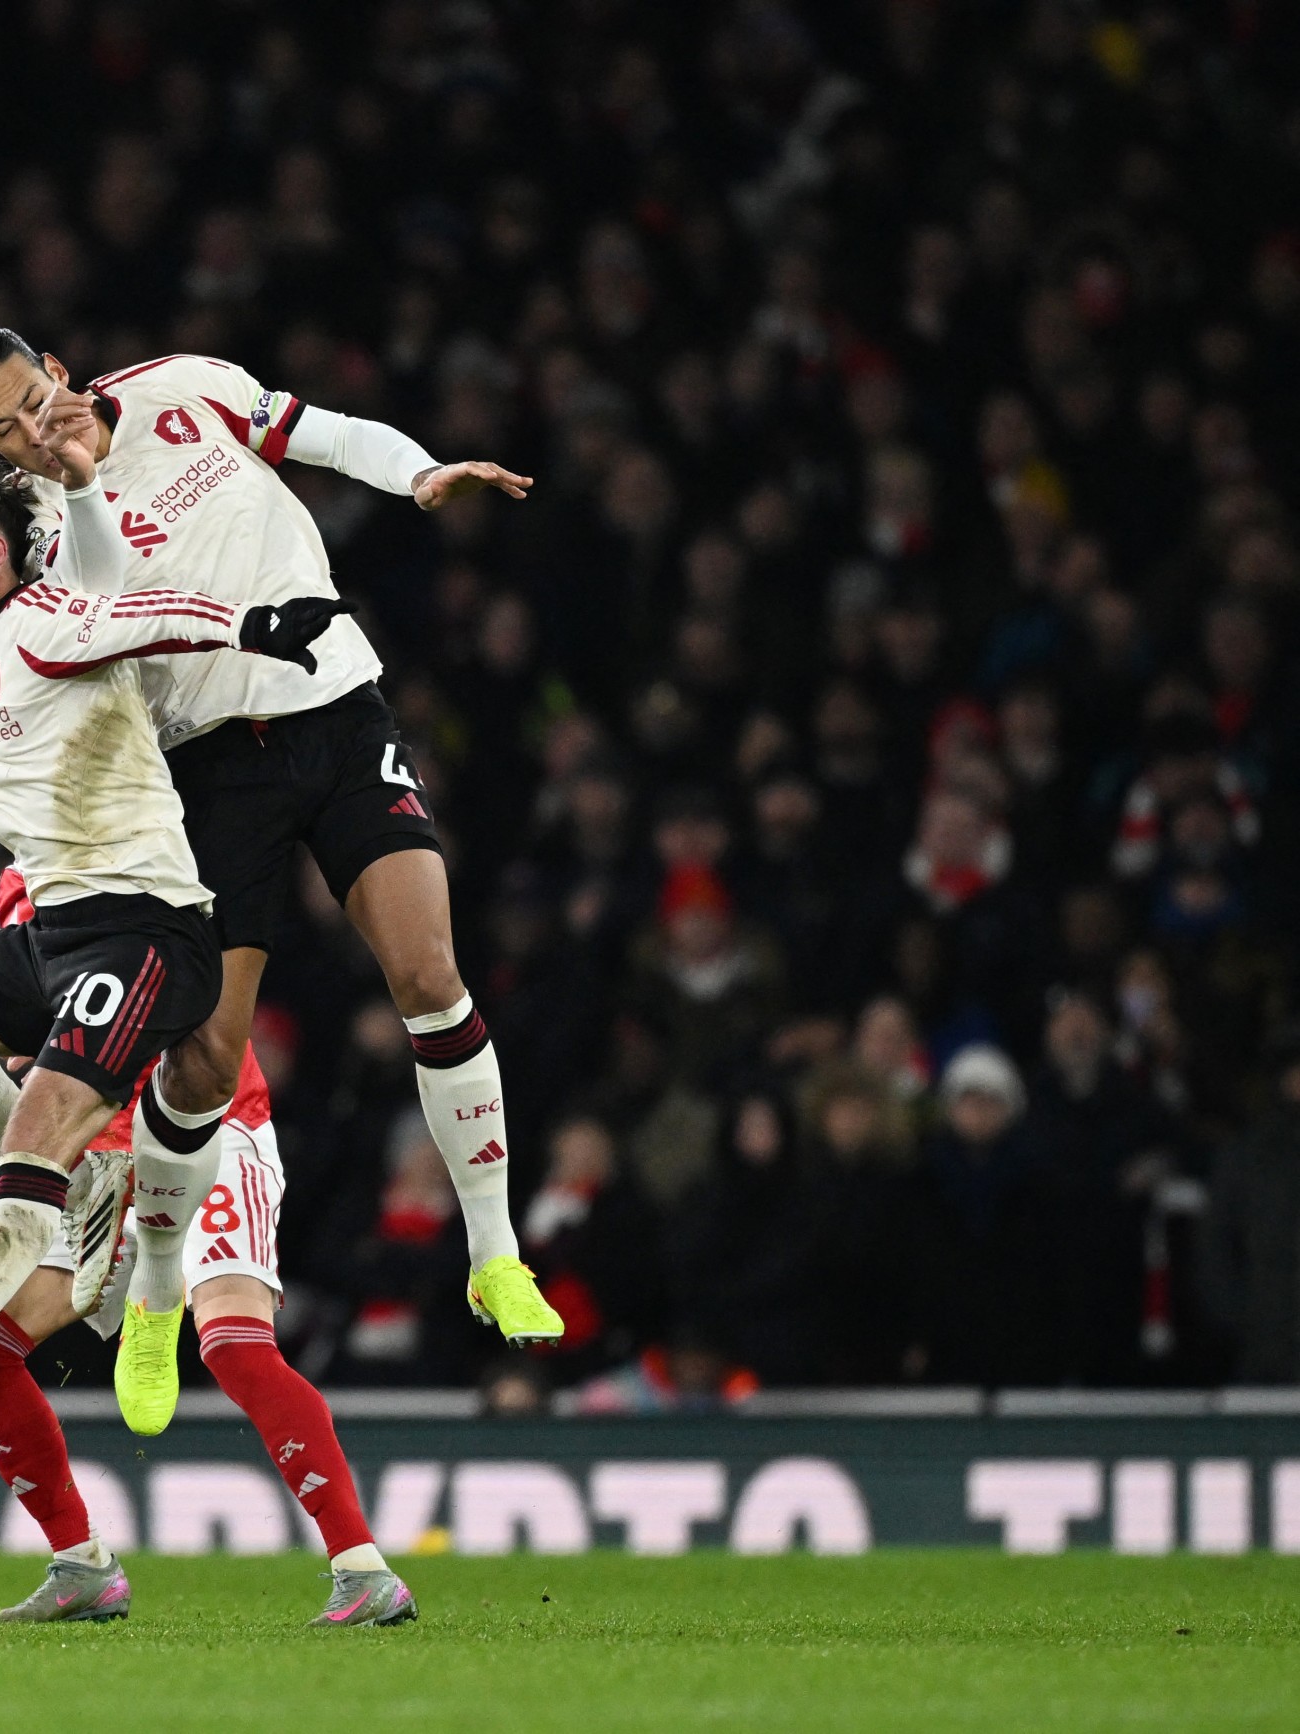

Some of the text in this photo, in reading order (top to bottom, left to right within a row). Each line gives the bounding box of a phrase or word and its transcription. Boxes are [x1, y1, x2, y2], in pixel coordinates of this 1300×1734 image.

[150, 444, 226, 513] standard
[163, 456, 241, 523] chartered
[77, 594, 114, 643] Exped
[380, 743, 420, 791] 4
[56, 971, 125, 1027] 10
[454, 1097, 501, 1121] LFC
[138, 1179, 187, 1197] LFC
[200, 1183, 241, 1234] 8
